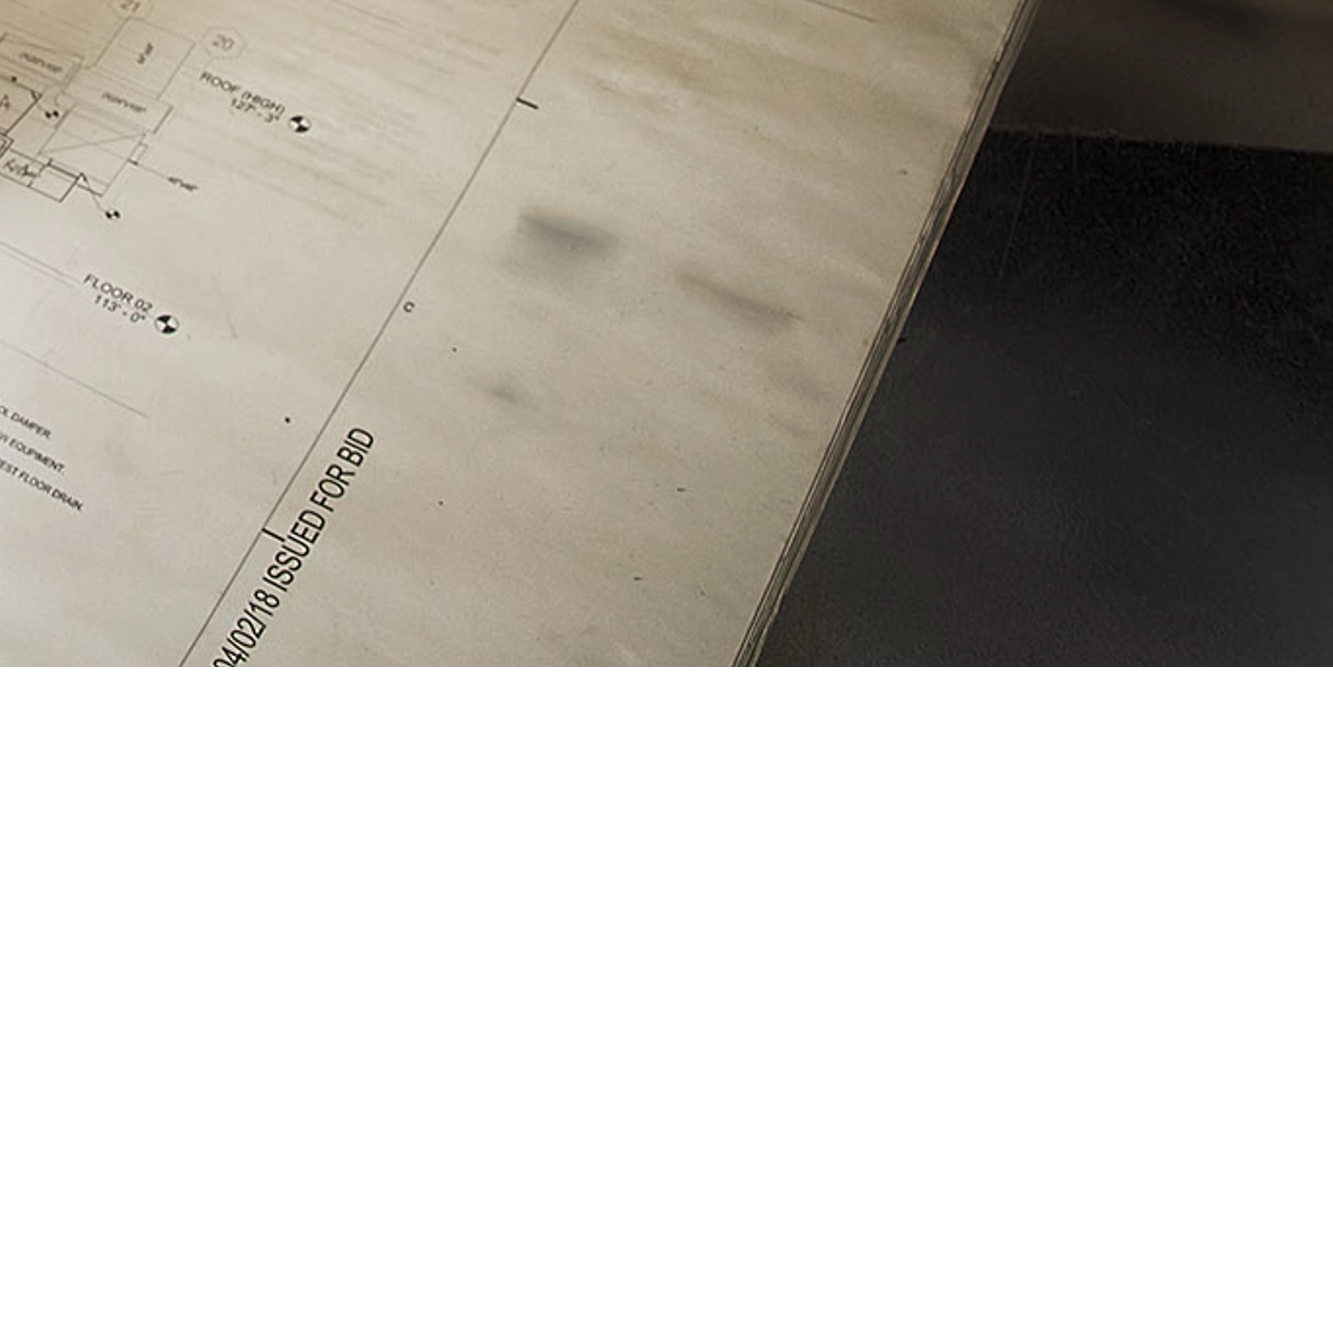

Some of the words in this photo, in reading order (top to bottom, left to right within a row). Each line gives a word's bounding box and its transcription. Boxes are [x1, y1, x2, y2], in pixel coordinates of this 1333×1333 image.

[211, 33, 235, 51] 20
[200, 71, 241, 93] ROOF
[240, 90, 286, 116] (HIGH)
[83, 273, 134, 304] FLOOR
[134, 298, 153, 313] 02
[18, 470, 54, 495] FLOOR
[262, 510, 326, 592] ISSUED
[310, 463, 356, 513] FOR
[337, 428, 375, 467] BID
